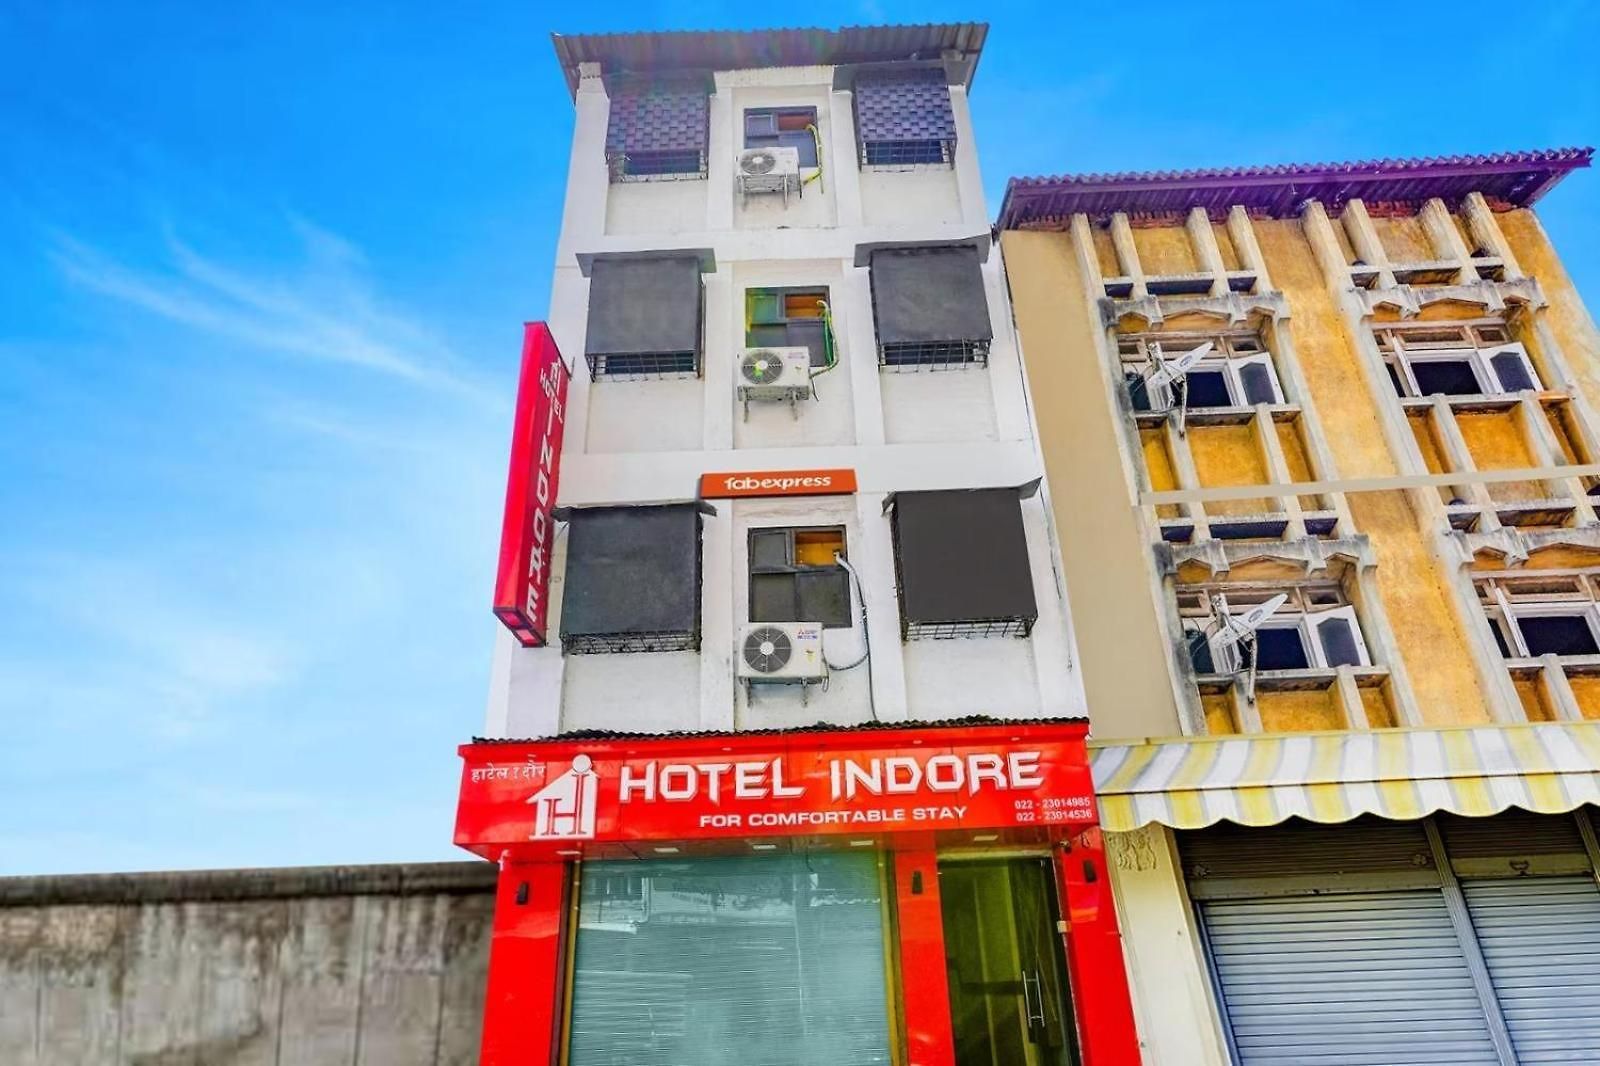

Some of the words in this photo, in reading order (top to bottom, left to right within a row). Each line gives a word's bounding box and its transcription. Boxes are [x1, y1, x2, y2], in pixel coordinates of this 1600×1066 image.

[540, 367, 563, 424] HOTEL
[724, 476, 831, 490] fabexpress
[527, 402, 554, 622] INDORE
[619, 758, 807, 807] HOTEL
[831, 752, 1044, 801] INDORE
[1014, 800, 1034, 810] 022
[700, 814, 741, 828] FOR
[748, 808, 905, 826] COMFORTABLE
[912, 806, 968, 820] STAY
[1016, 812, 1035, 822] 022
